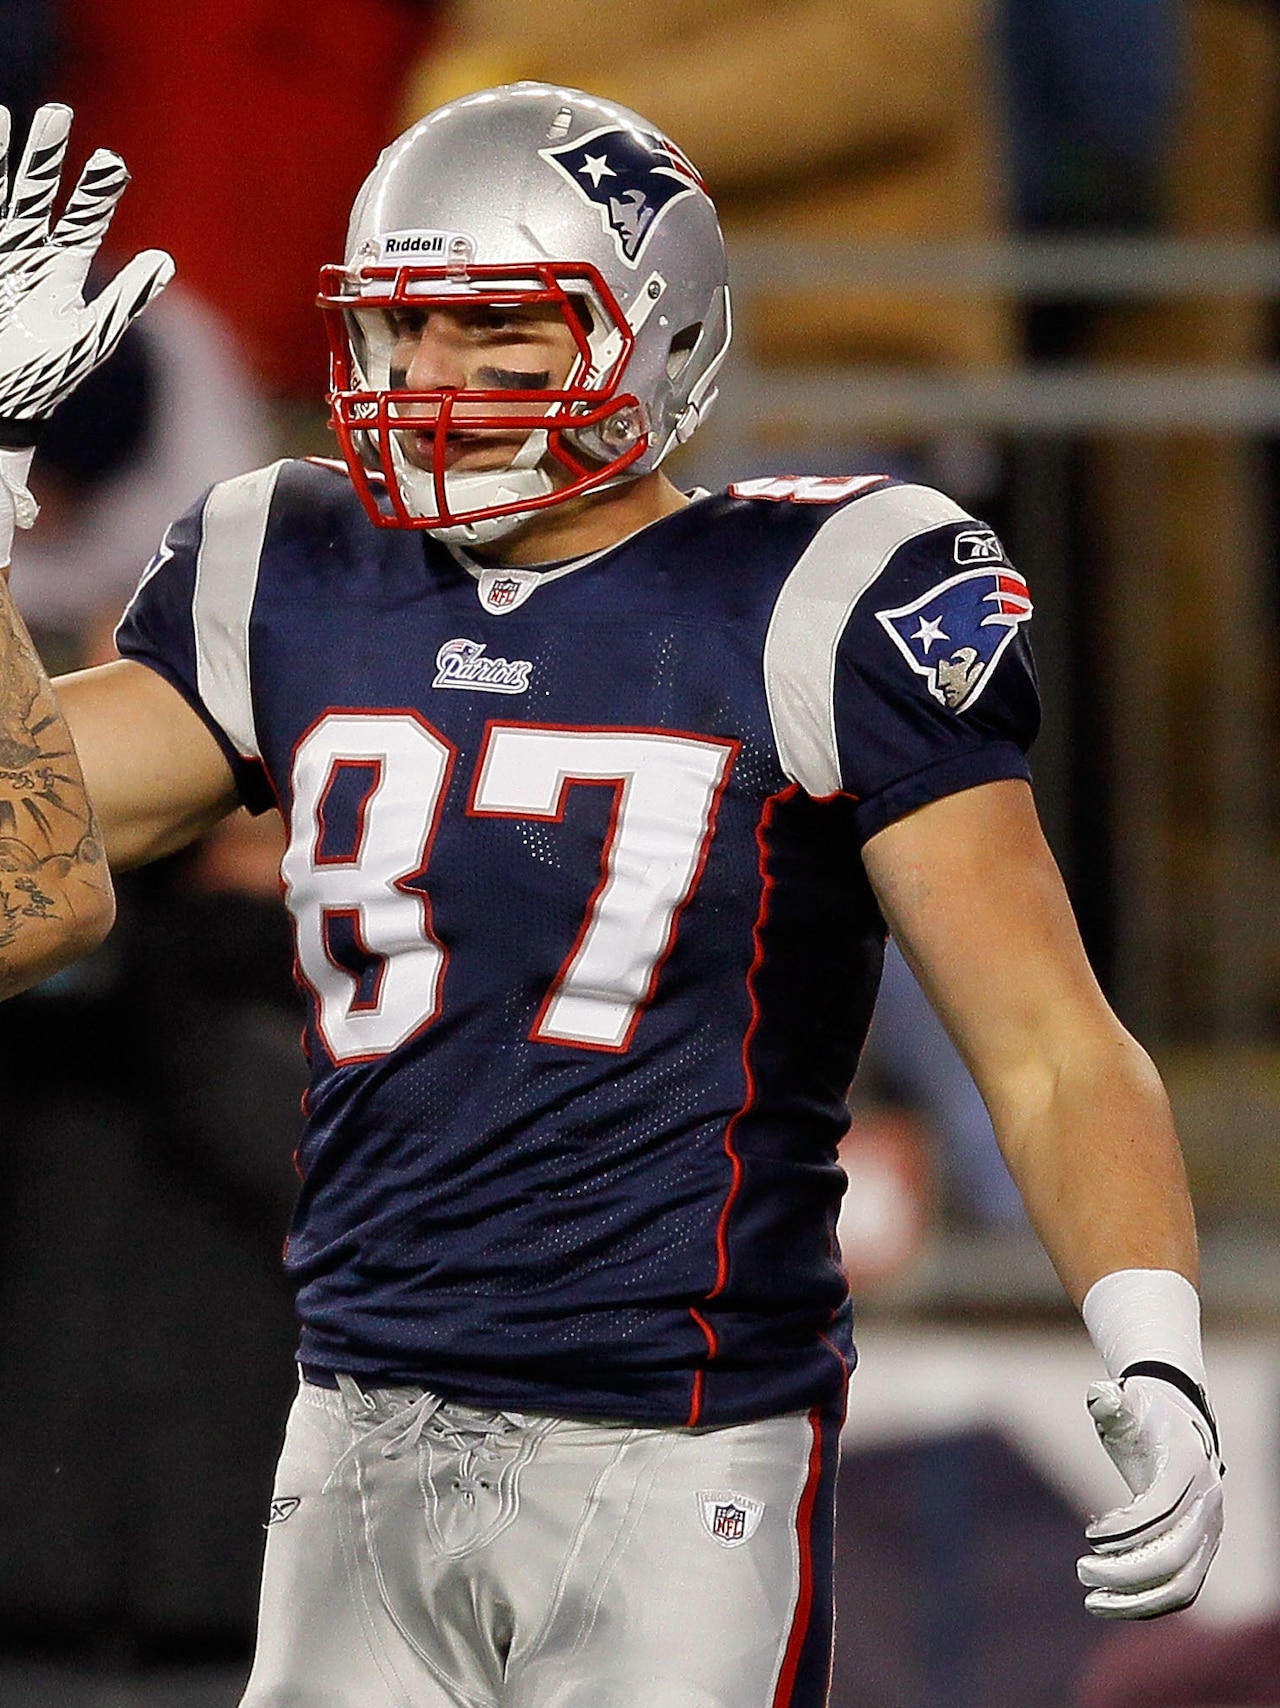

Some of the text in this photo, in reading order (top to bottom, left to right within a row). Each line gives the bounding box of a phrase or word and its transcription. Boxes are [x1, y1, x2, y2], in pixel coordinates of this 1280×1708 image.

[385, 236, 443, 252] Riddell
[490, 588, 514, 604] NFL
[435, 653, 532, 688] Patriots
[279, 707, 741, 1068] 87
[716, 1518, 742, 1537] NFL
